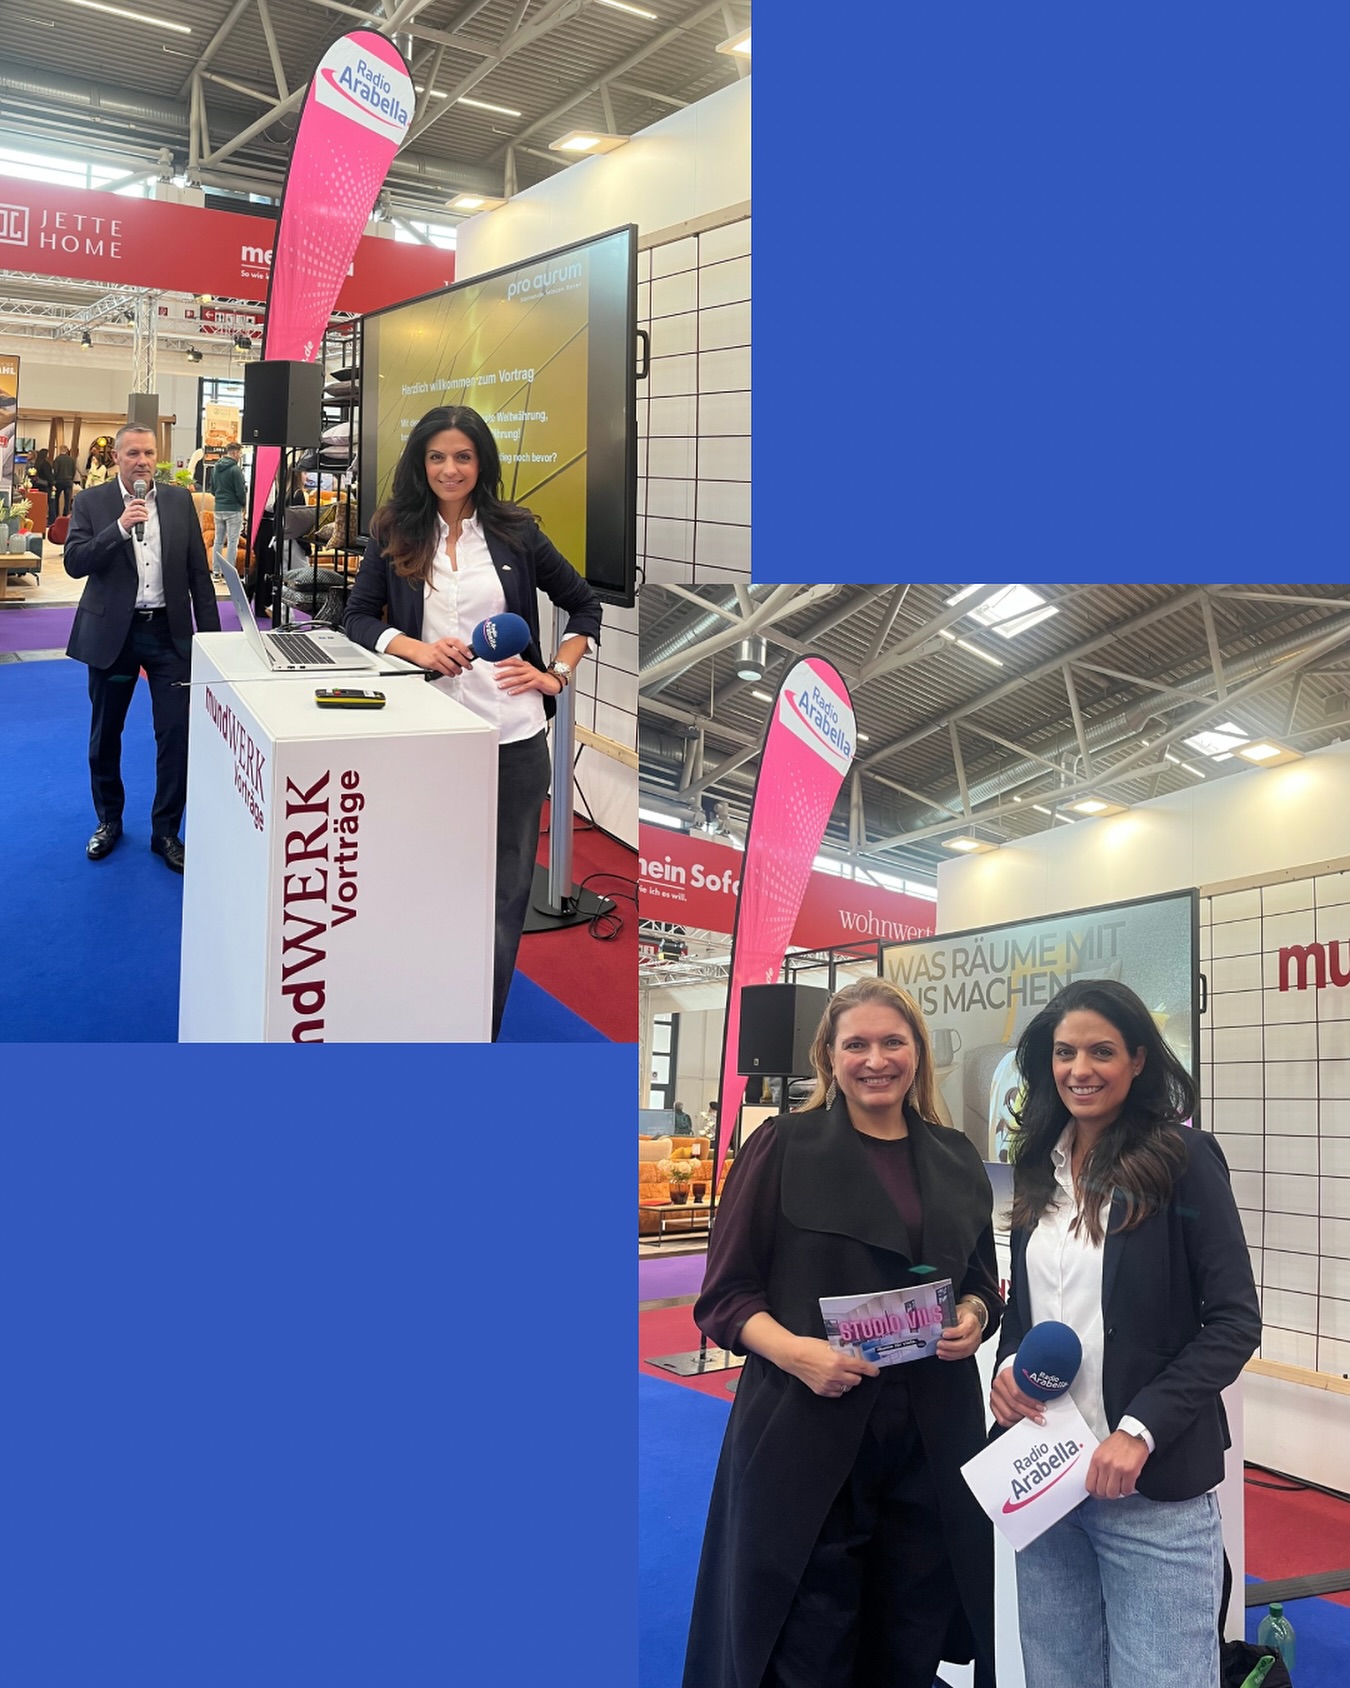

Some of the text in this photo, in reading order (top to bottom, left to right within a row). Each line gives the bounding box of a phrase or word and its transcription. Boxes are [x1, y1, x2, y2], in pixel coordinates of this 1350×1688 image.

[357, 59, 391, 94] Radio
[40, 210, 122, 237] JETTE
[40, 232, 122, 259] HOME
[241, 269, 249, 277] So
[507, 278, 531, 301] pro
[533, 262, 582, 289] aurum
[401, 368, 535, 395] Herzlich willkommen zum Vortrag
[513, 453, 530, 462] noch
[532, 452, 558, 462] bevor?
[812, 686, 839, 724] Radio
[205, 685, 266, 803] mundWERK
[234, 760, 265, 832] Vorträge
[331, 769, 365, 928] Vorträge
[649, 886, 660, 896] ich
[888, 921, 1126, 985] WAS RÄUME MIT
[944, 969, 1072, 1014] MACHEN
[839, 1313, 902, 1341] STUDIO
[1039, 1371, 1060, 1382] Radio
[1013, 1443, 1049, 1475] Radio
